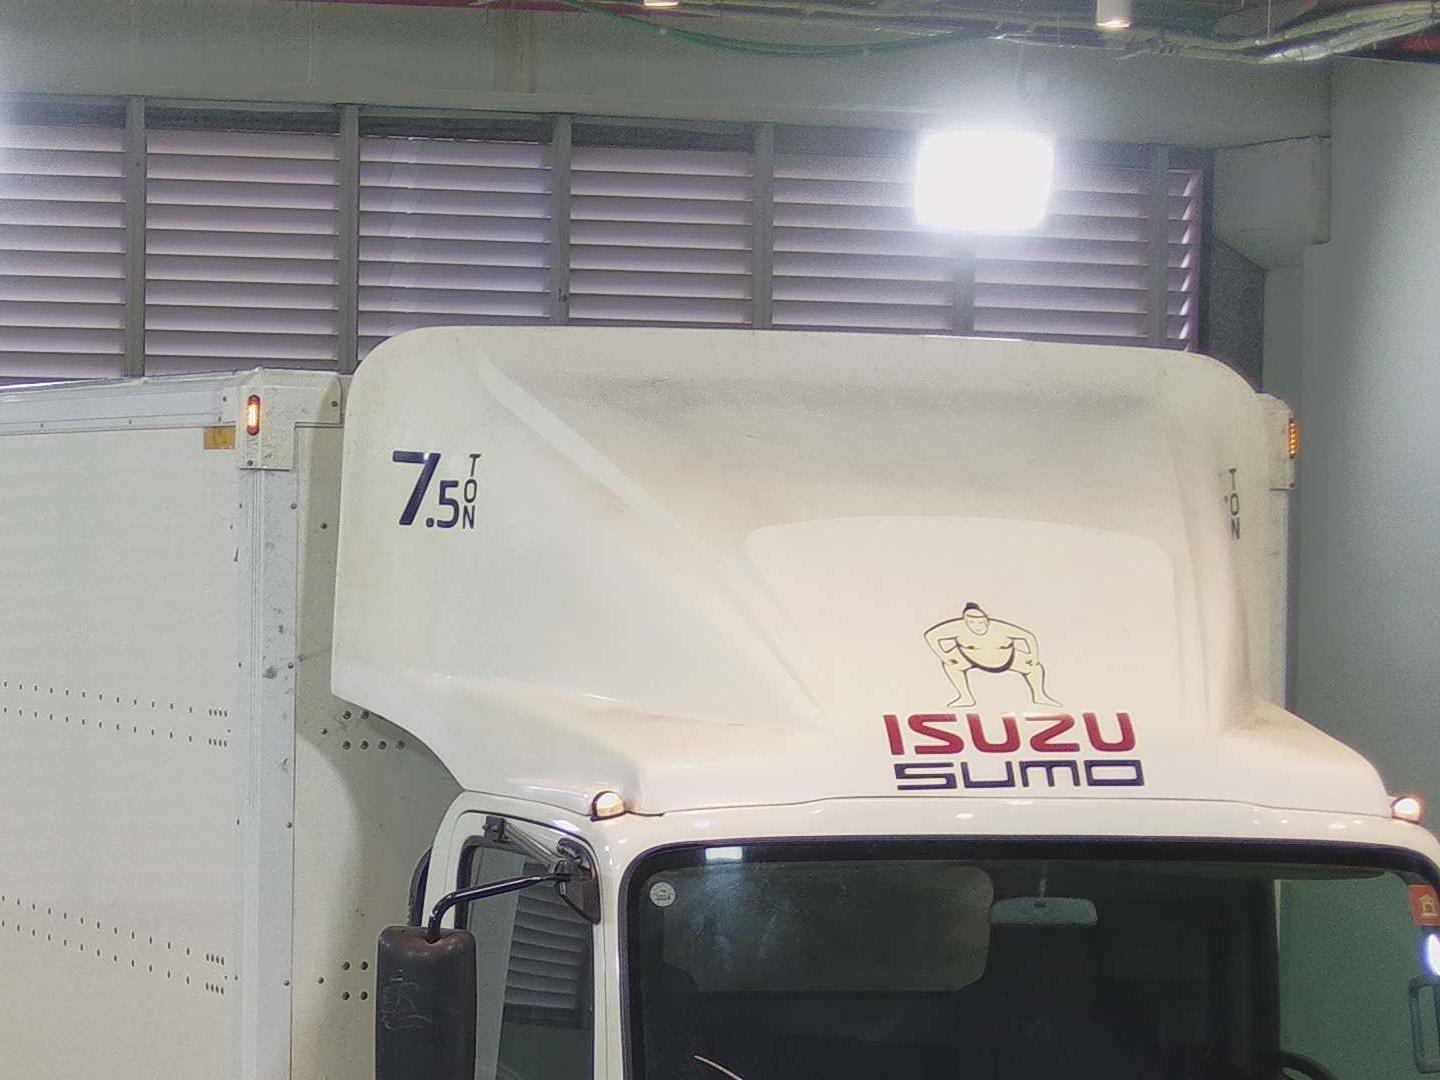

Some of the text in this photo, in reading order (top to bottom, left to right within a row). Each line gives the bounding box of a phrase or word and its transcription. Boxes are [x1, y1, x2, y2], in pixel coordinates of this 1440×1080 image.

[392, 450, 482, 530] 7.5 TON
[883, 712, 1137, 756] ISUZU
[893, 759, 1146, 791] SUMO
